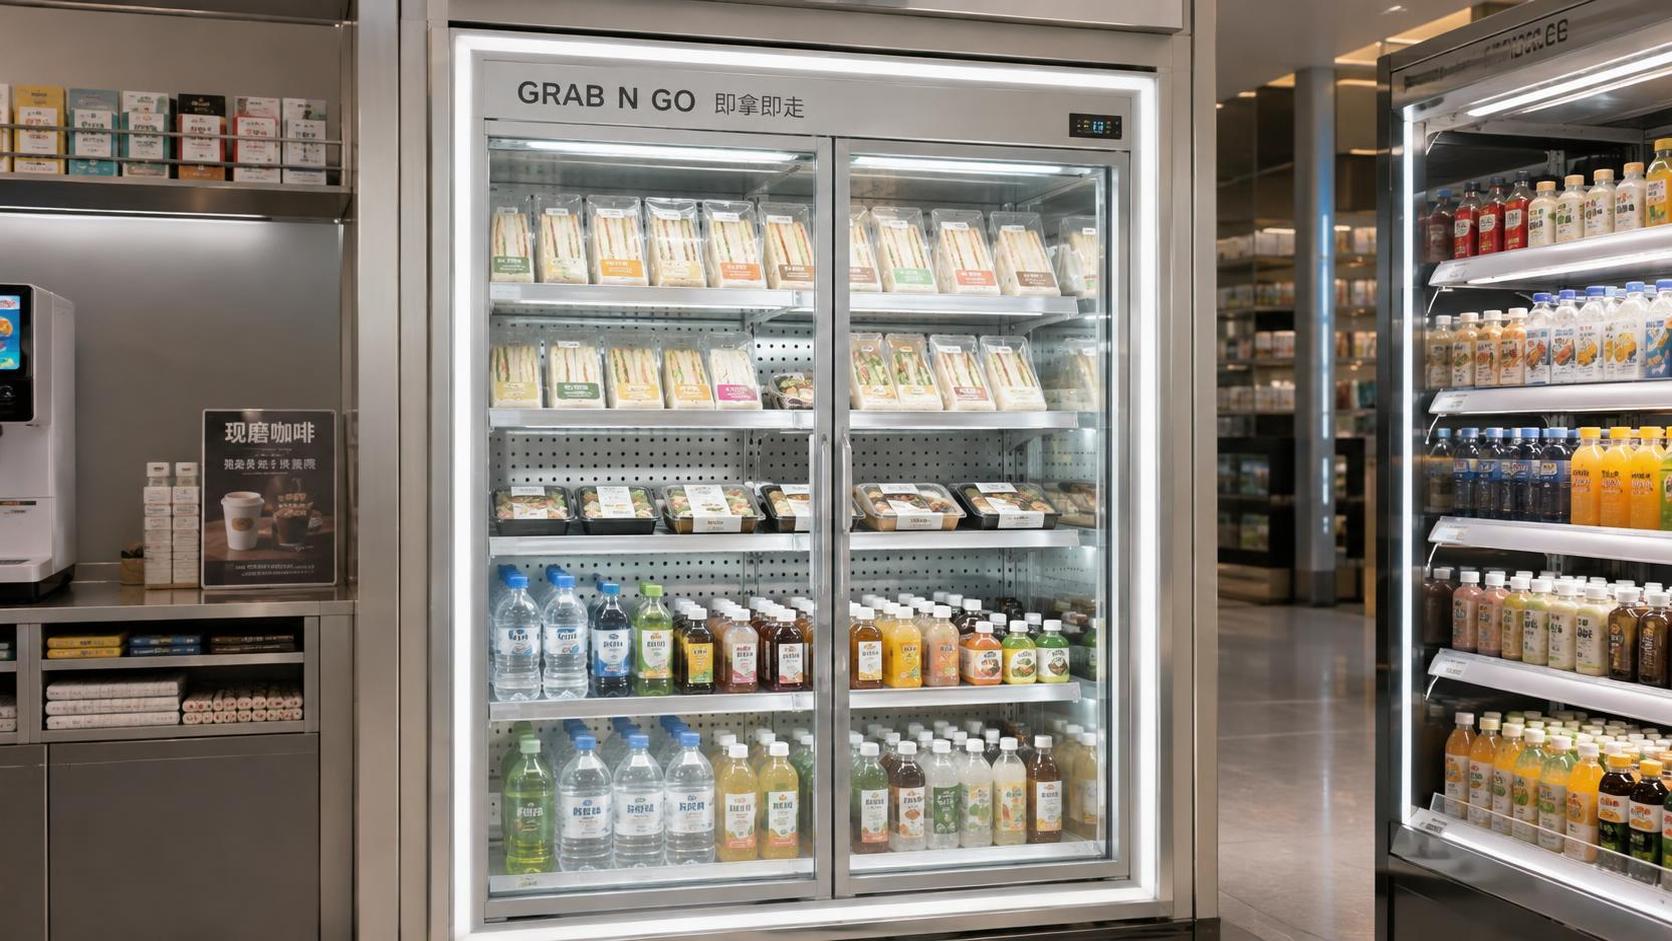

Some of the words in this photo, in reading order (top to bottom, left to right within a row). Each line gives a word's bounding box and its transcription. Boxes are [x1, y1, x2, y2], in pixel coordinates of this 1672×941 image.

[517, 80, 605, 108] GRAB
[618, 86, 638, 109] N
[651, 88, 696, 112] GO
[714, 92, 805, 119] 即拿即走
[224, 421, 316, 444] 现磨咖啡
